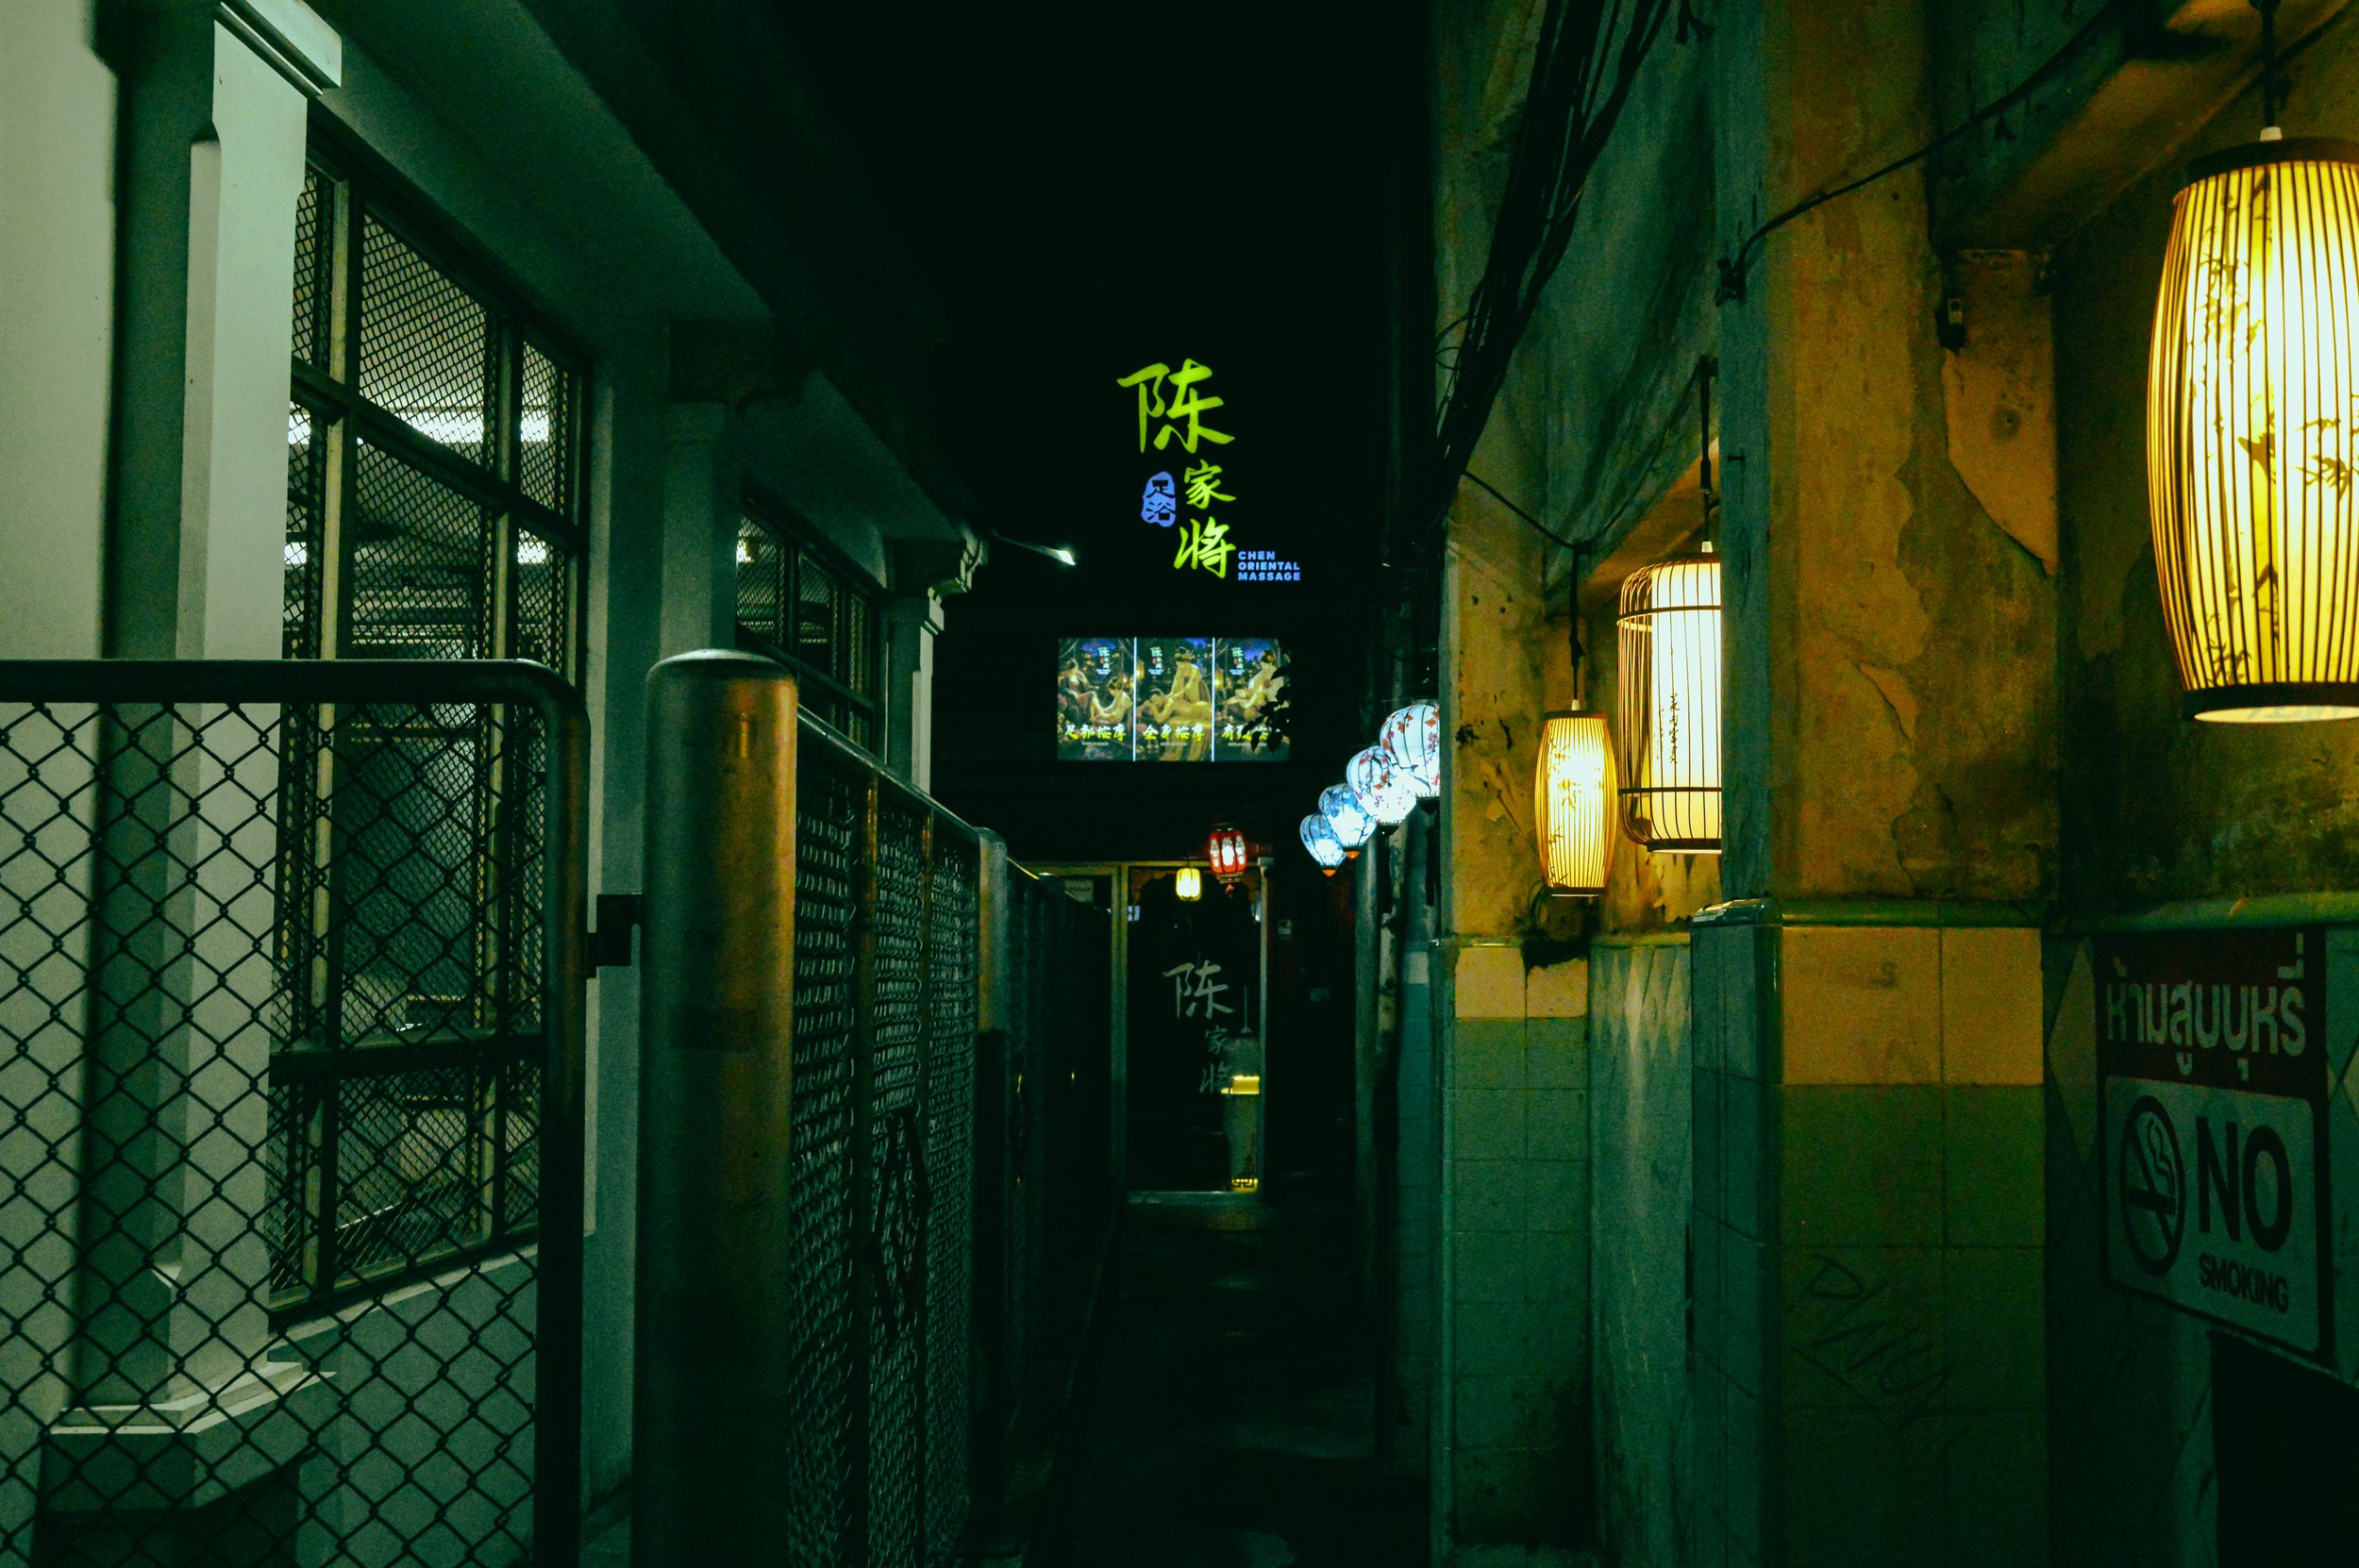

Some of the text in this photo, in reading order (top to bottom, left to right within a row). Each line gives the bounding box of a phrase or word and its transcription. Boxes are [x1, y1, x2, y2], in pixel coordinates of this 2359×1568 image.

[1238, 551, 1276, 560] CHEN
[1238, 561, 1300, 571] ORIENTAL
[1238, 572, 1300, 581] MASSAGE
[2105, 932, 2306, 1082] ห้ามสูบบุหรี่
[2196, 1116, 2292, 1253] NO
[2199, 1252, 2289, 1314] SMOKING
